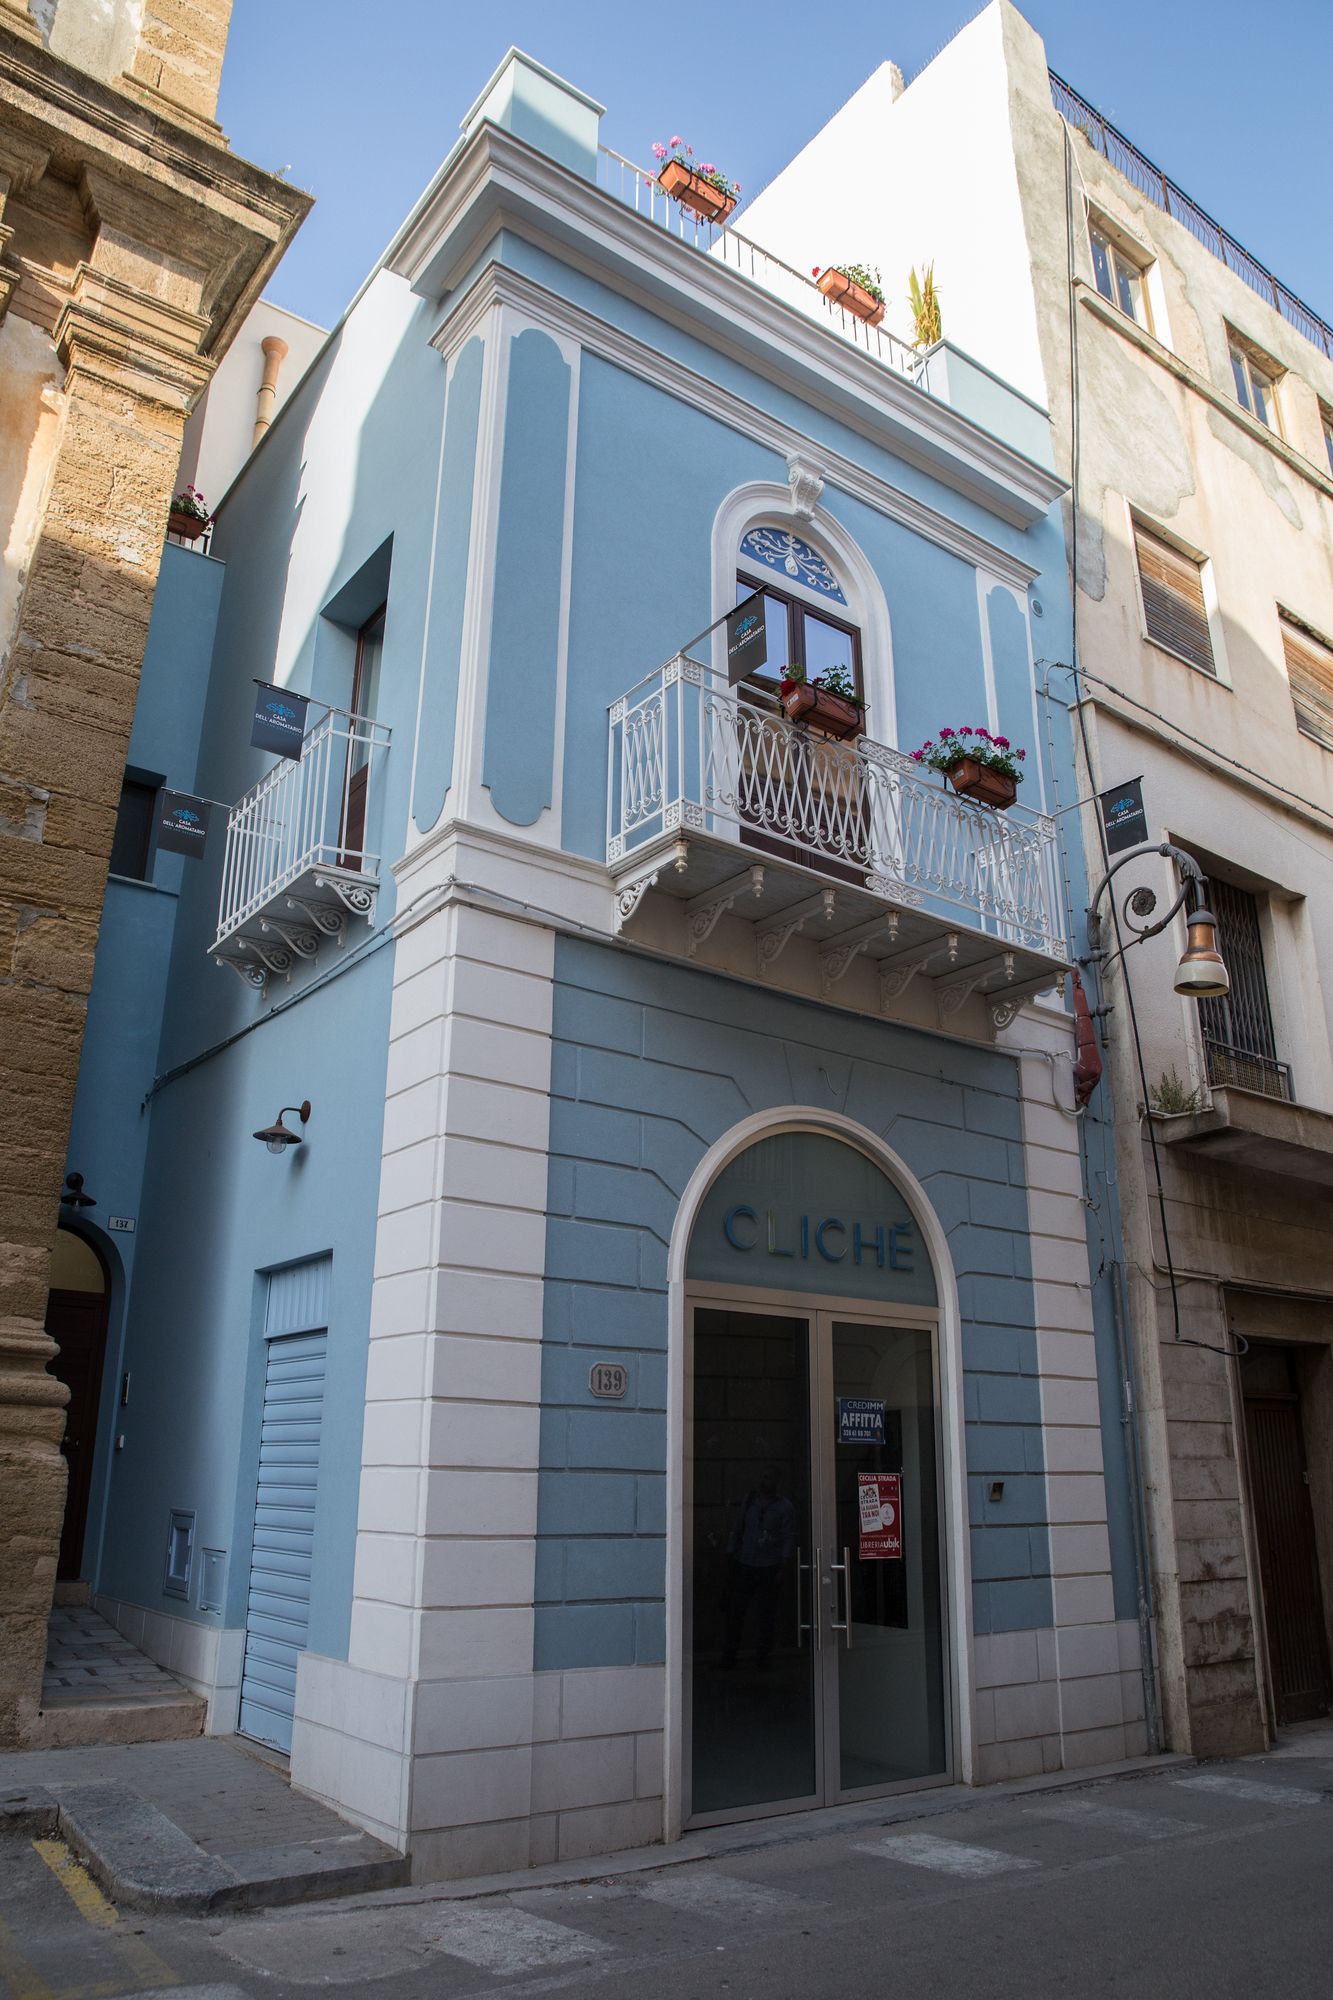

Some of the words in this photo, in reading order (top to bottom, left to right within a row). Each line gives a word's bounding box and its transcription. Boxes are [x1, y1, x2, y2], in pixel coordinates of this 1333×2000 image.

[741, 629, 752, 638] CASA
[273, 714, 286, 722] CASA
[115, 1220, 128, 1228] 137
[724, 1204, 914, 1271] CLICHÉ
[598, 1369, 622, 1391] 139
[847, 1401, 883, 1410] CREDIMM
[841, 1412, 883, 1429] AFFITTA
